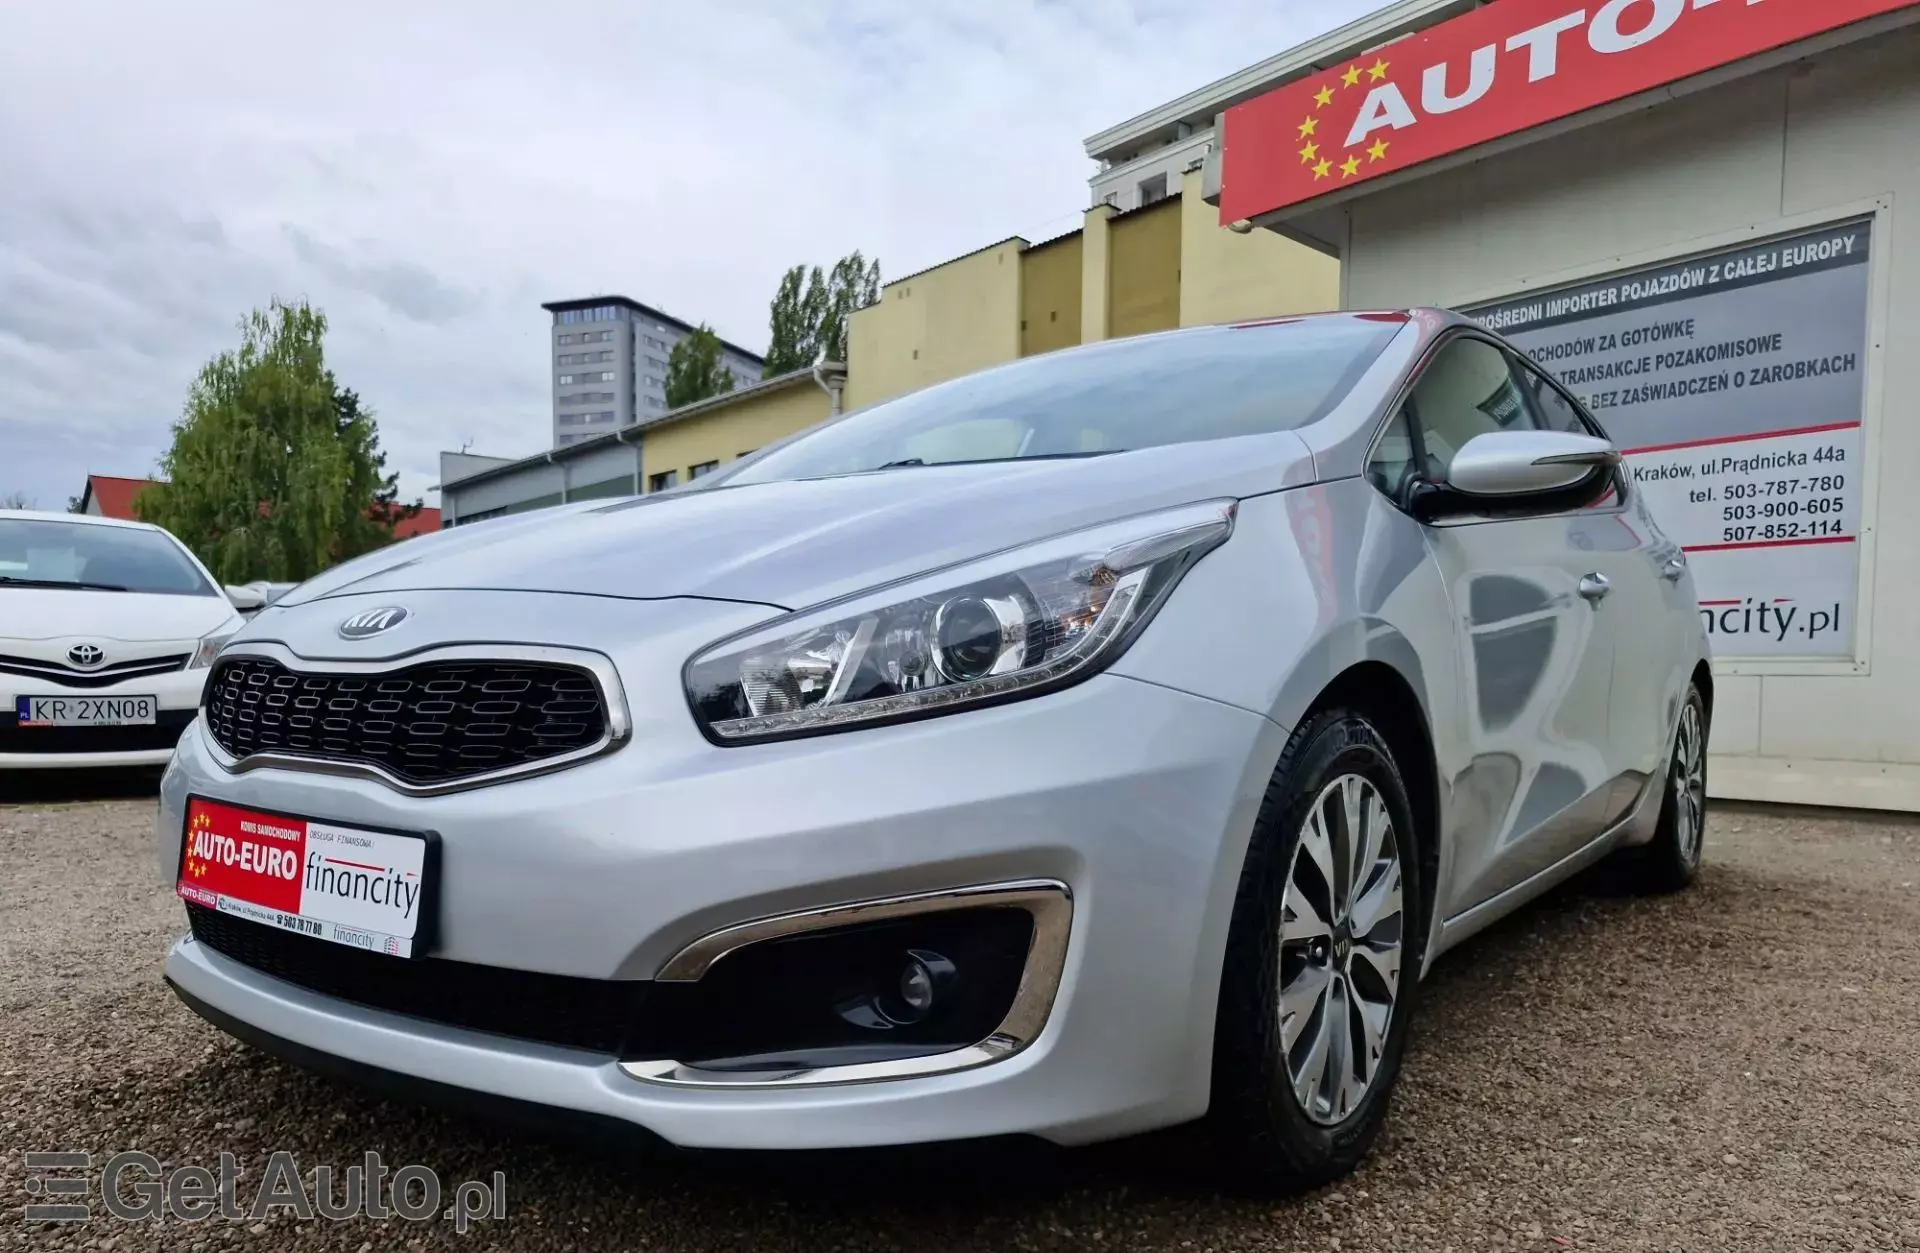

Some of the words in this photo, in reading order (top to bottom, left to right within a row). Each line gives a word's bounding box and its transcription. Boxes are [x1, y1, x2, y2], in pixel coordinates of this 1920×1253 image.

[1343, 0, 1765, 148] AUTO
[1473, 304, 1542, 330] POŚREDNI
[1546, 288, 1617, 318] IMPORTER
[1621, 268, 1705, 302] POJAZDÓW
[1709, 268, 1720, 284] Z
[1724, 251, 1777, 280] CAŁEJ
[1782, 235, 1856, 268] EUROPY
[1599, 335, 1617, 351] ZA
[1621, 319, 1695, 347] GOTÓWKĘ
[1560, 356, 1651, 386] TRANSAKCJE
[1655, 333, 1782, 370] POZAKOMISOWE
[1591, 392, 1618, 410] BEZ
[1621, 371, 1729, 406] ZAŚWIADCZEŃ
[1734, 370, 1745, 388] O
[1750, 353, 1856, 386] ZAROBKACH
[1633, 462, 1696, 482] Kraków,
[1701, 451, 1807, 476] ul.Prądnicka
[1813, 446, 1846, 463] 44a
[1689, 487, 1717, 503] tel.
[1723, 475, 1845, 500] 503-787-780
[1723, 498, 1844, 521] 503-900-605
[1723, 519, 1843, 542] 507-852-114
[36, 700, 66, 720] KR
[78, 700, 149, 720] 2XN08
[257, 824, 301, 842] SAMOCHODOWY
[193, 830, 297, 880] AUTO-EURO
[181, 886, 216, 905] AUTO-EURO
[306, 852, 419, 919] financity
[284, 914, 296, 928] 503
[333, 924, 375, 949] financity
